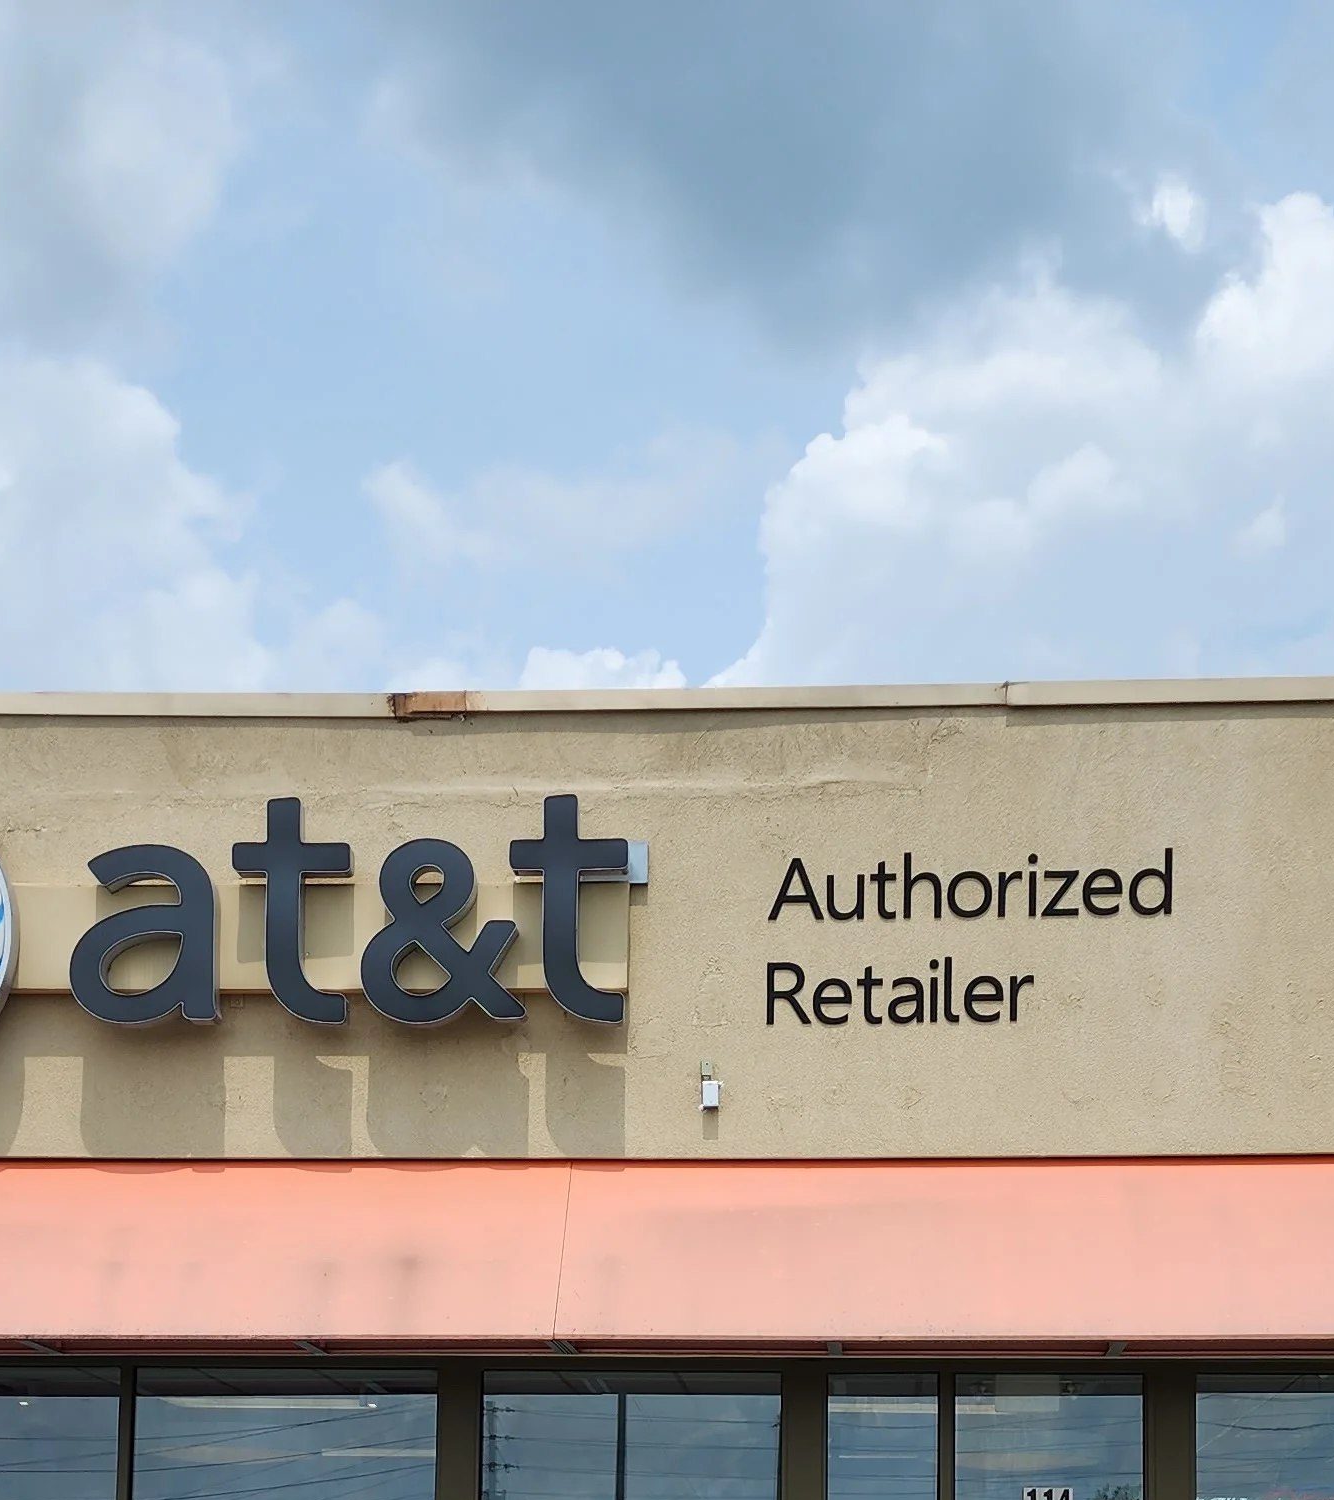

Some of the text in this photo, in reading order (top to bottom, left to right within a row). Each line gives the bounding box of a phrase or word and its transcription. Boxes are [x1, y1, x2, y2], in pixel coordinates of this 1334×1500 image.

[69, 794, 631, 1026] at&t
[767, 846, 1174, 921] Authorized
[765, 955, 1035, 1026] Retailer
